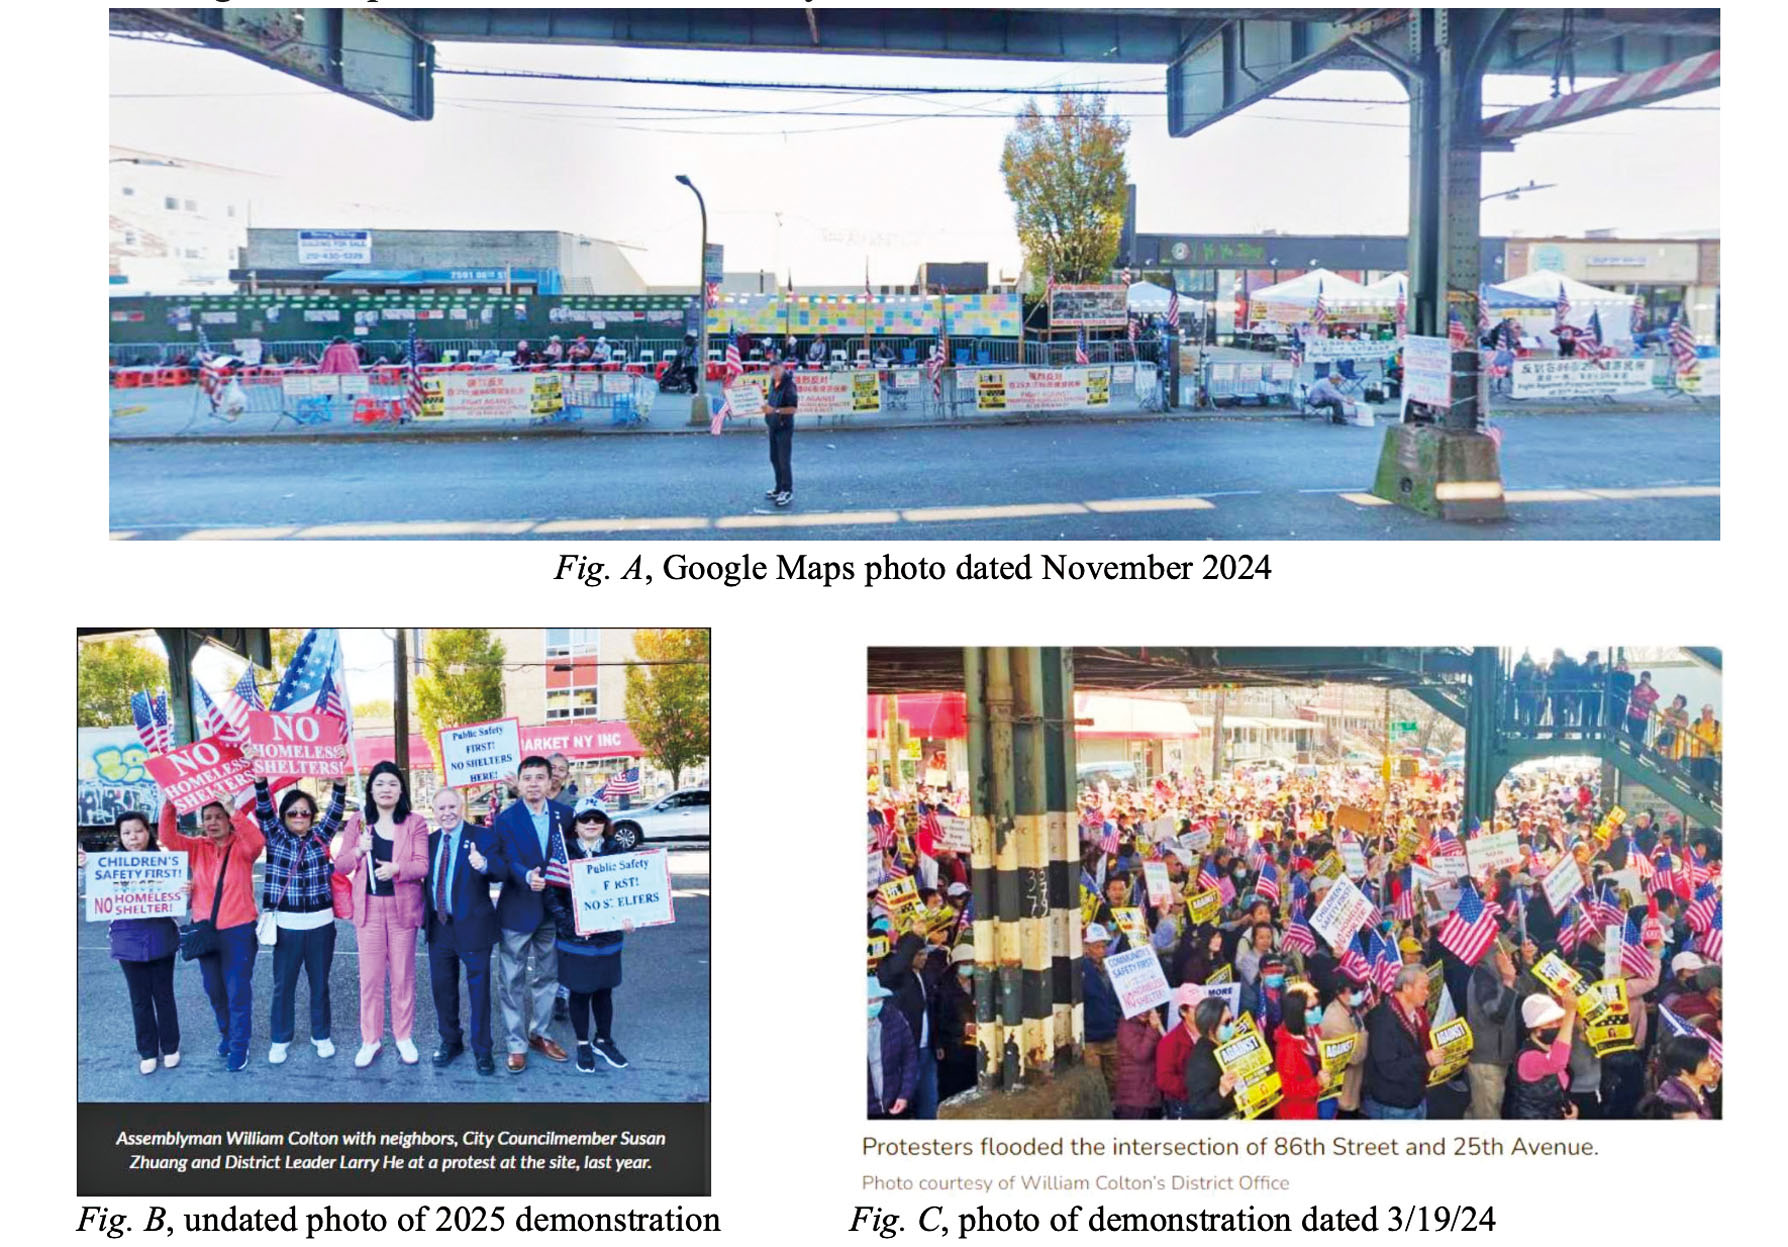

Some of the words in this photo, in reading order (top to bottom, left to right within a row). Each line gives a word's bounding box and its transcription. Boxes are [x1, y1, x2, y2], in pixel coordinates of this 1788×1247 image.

[270, 715, 320, 742] NO
[452, 728, 477, 741] Public
[479, 725, 504, 737] Safety
[573, 735, 593, 748] NY
[598, 733, 622, 746] INC
[253, 743, 342, 758] HOMELESS
[166, 742, 220, 776] NO
[451, 760, 465, 771] NO
[466, 753, 513, 769] SHELTERS
[254, 760, 344, 774] SHELTERS!
[164, 756, 250, 799] HOMELESS
[470, 771, 499, 783] HERE!
[98, 856, 179, 868] CHILDREN'S
[587, 863, 616, 874] Public
[619, 859, 649, 870] Safety
[95, 869, 141, 880] SAFETY
[144, 868, 182, 879] FIRST!
[603, 877, 640, 891] FRST!
[94, 896, 113, 914] NO
[114, 892, 181, 903] HOMELESS
[116, 903, 173, 915] SHELTER!
[584, 900, 600, 911] NO
[602, 892, 660, 909] SELTERS
[1208, 987, 1233, 996] MORE
[1221, 1036, 1259, 1064] AGAINST
